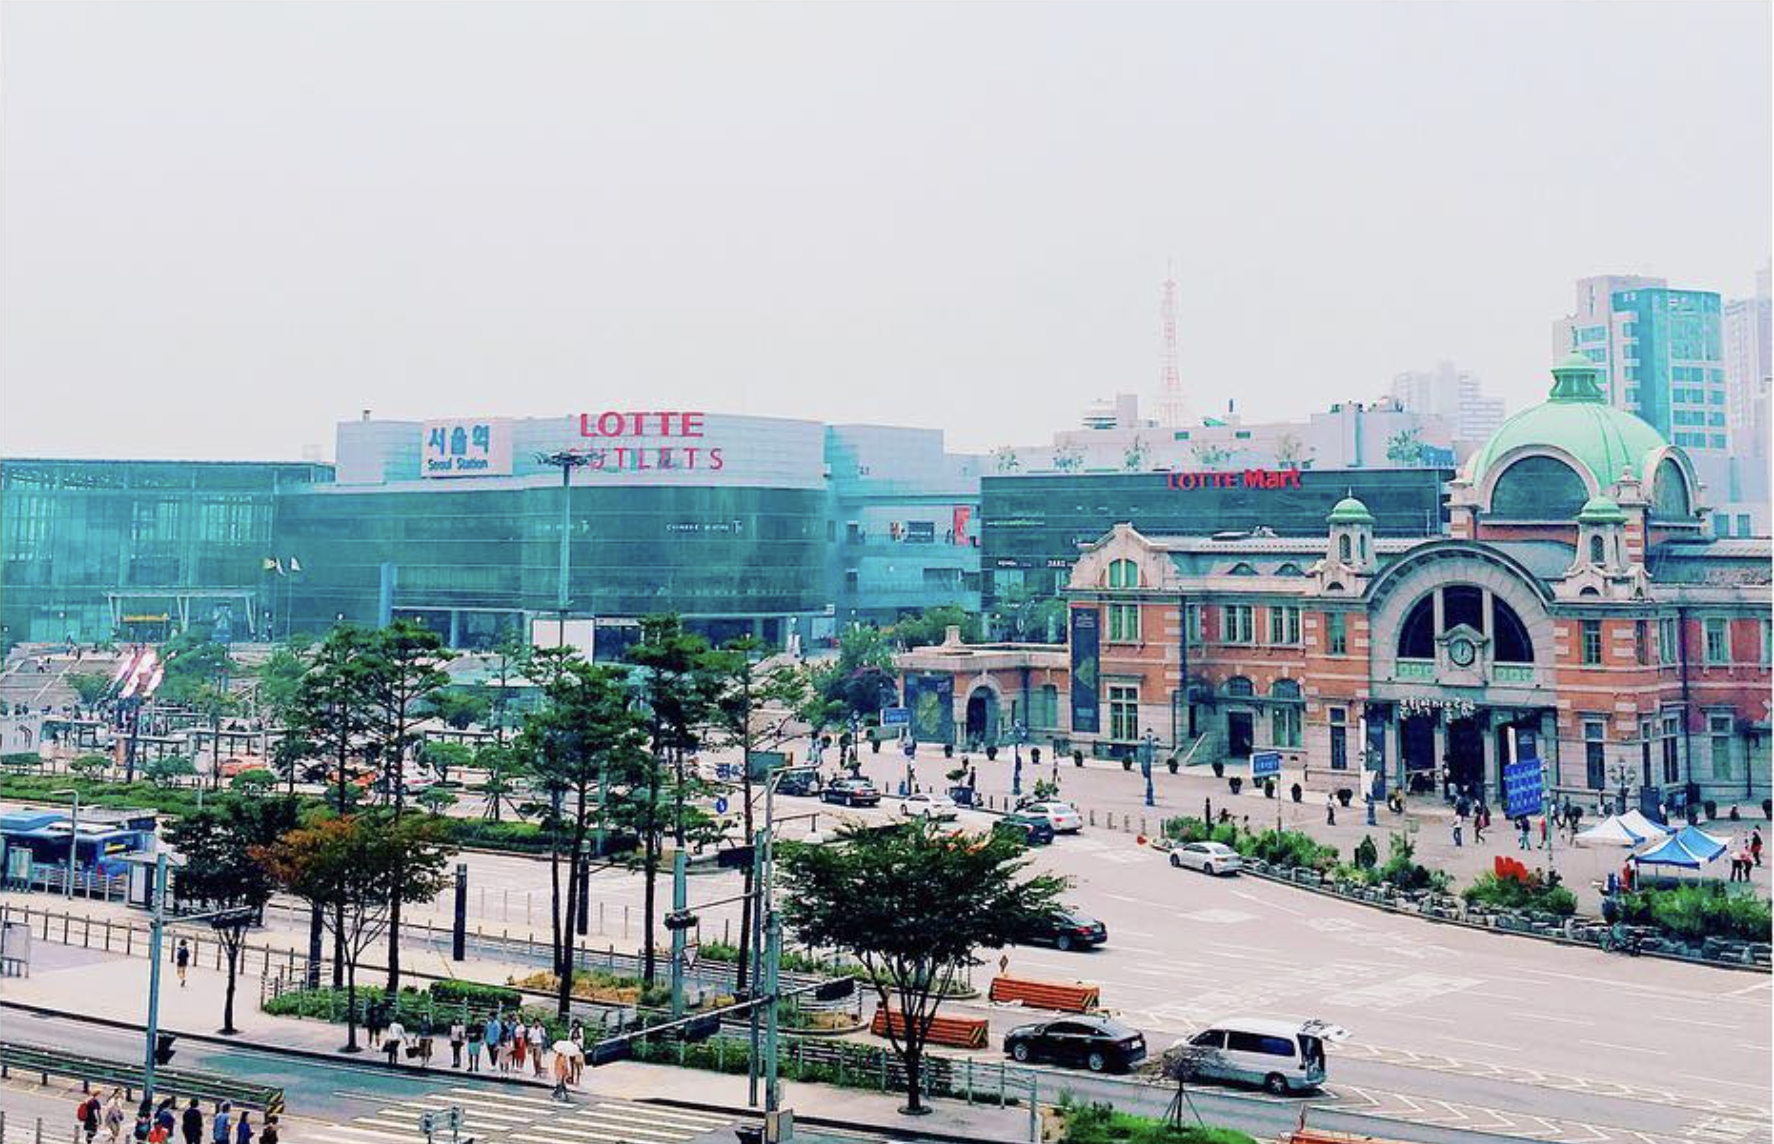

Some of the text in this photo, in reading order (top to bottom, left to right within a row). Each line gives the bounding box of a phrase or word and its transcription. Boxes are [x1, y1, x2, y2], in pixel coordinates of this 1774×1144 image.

[580, 411, 705, 437] LOTTE
[428, 424, 490, 456] 서울역
[428, 457, 488, 471] Seoul Station
[1167, 468, 1301, 491] LOTTE Mart
